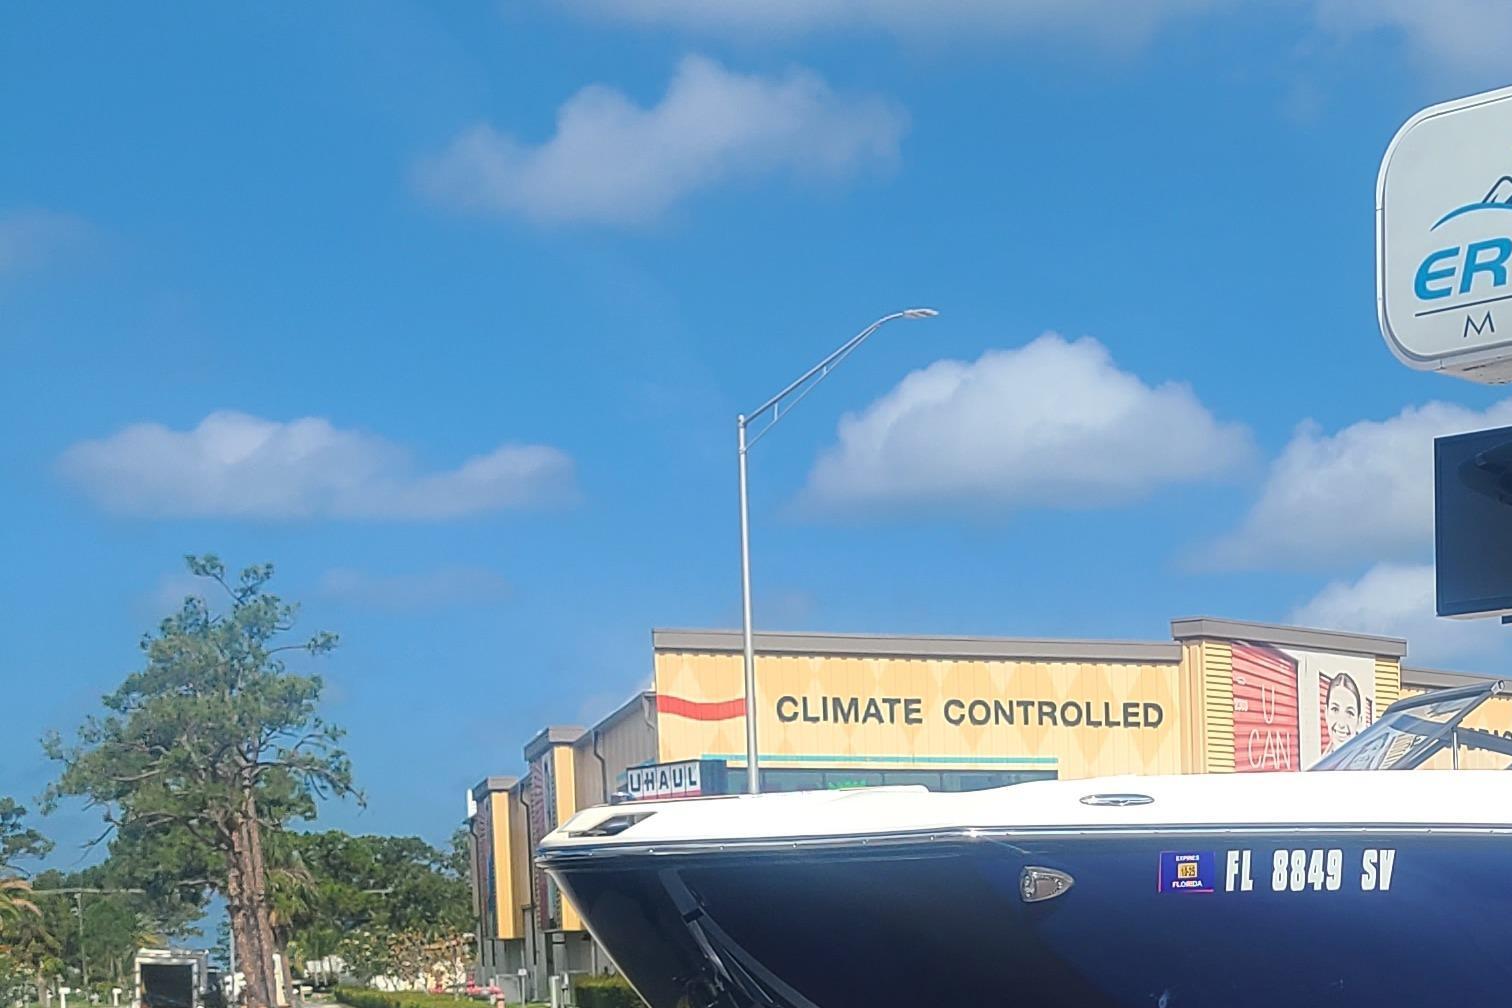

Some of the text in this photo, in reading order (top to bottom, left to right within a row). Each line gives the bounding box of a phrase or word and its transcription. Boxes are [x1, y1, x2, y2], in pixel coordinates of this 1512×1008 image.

[776, 695, 1164, 728] CLIMATE CONTROLLED
[1262, 684, 1275, 724] U
[1248, 729, 1290, 769] CAN
[1172, 880, 1202, 888] FLORIDA
[1226, 849, 1396, 891] FL 8849 SV
